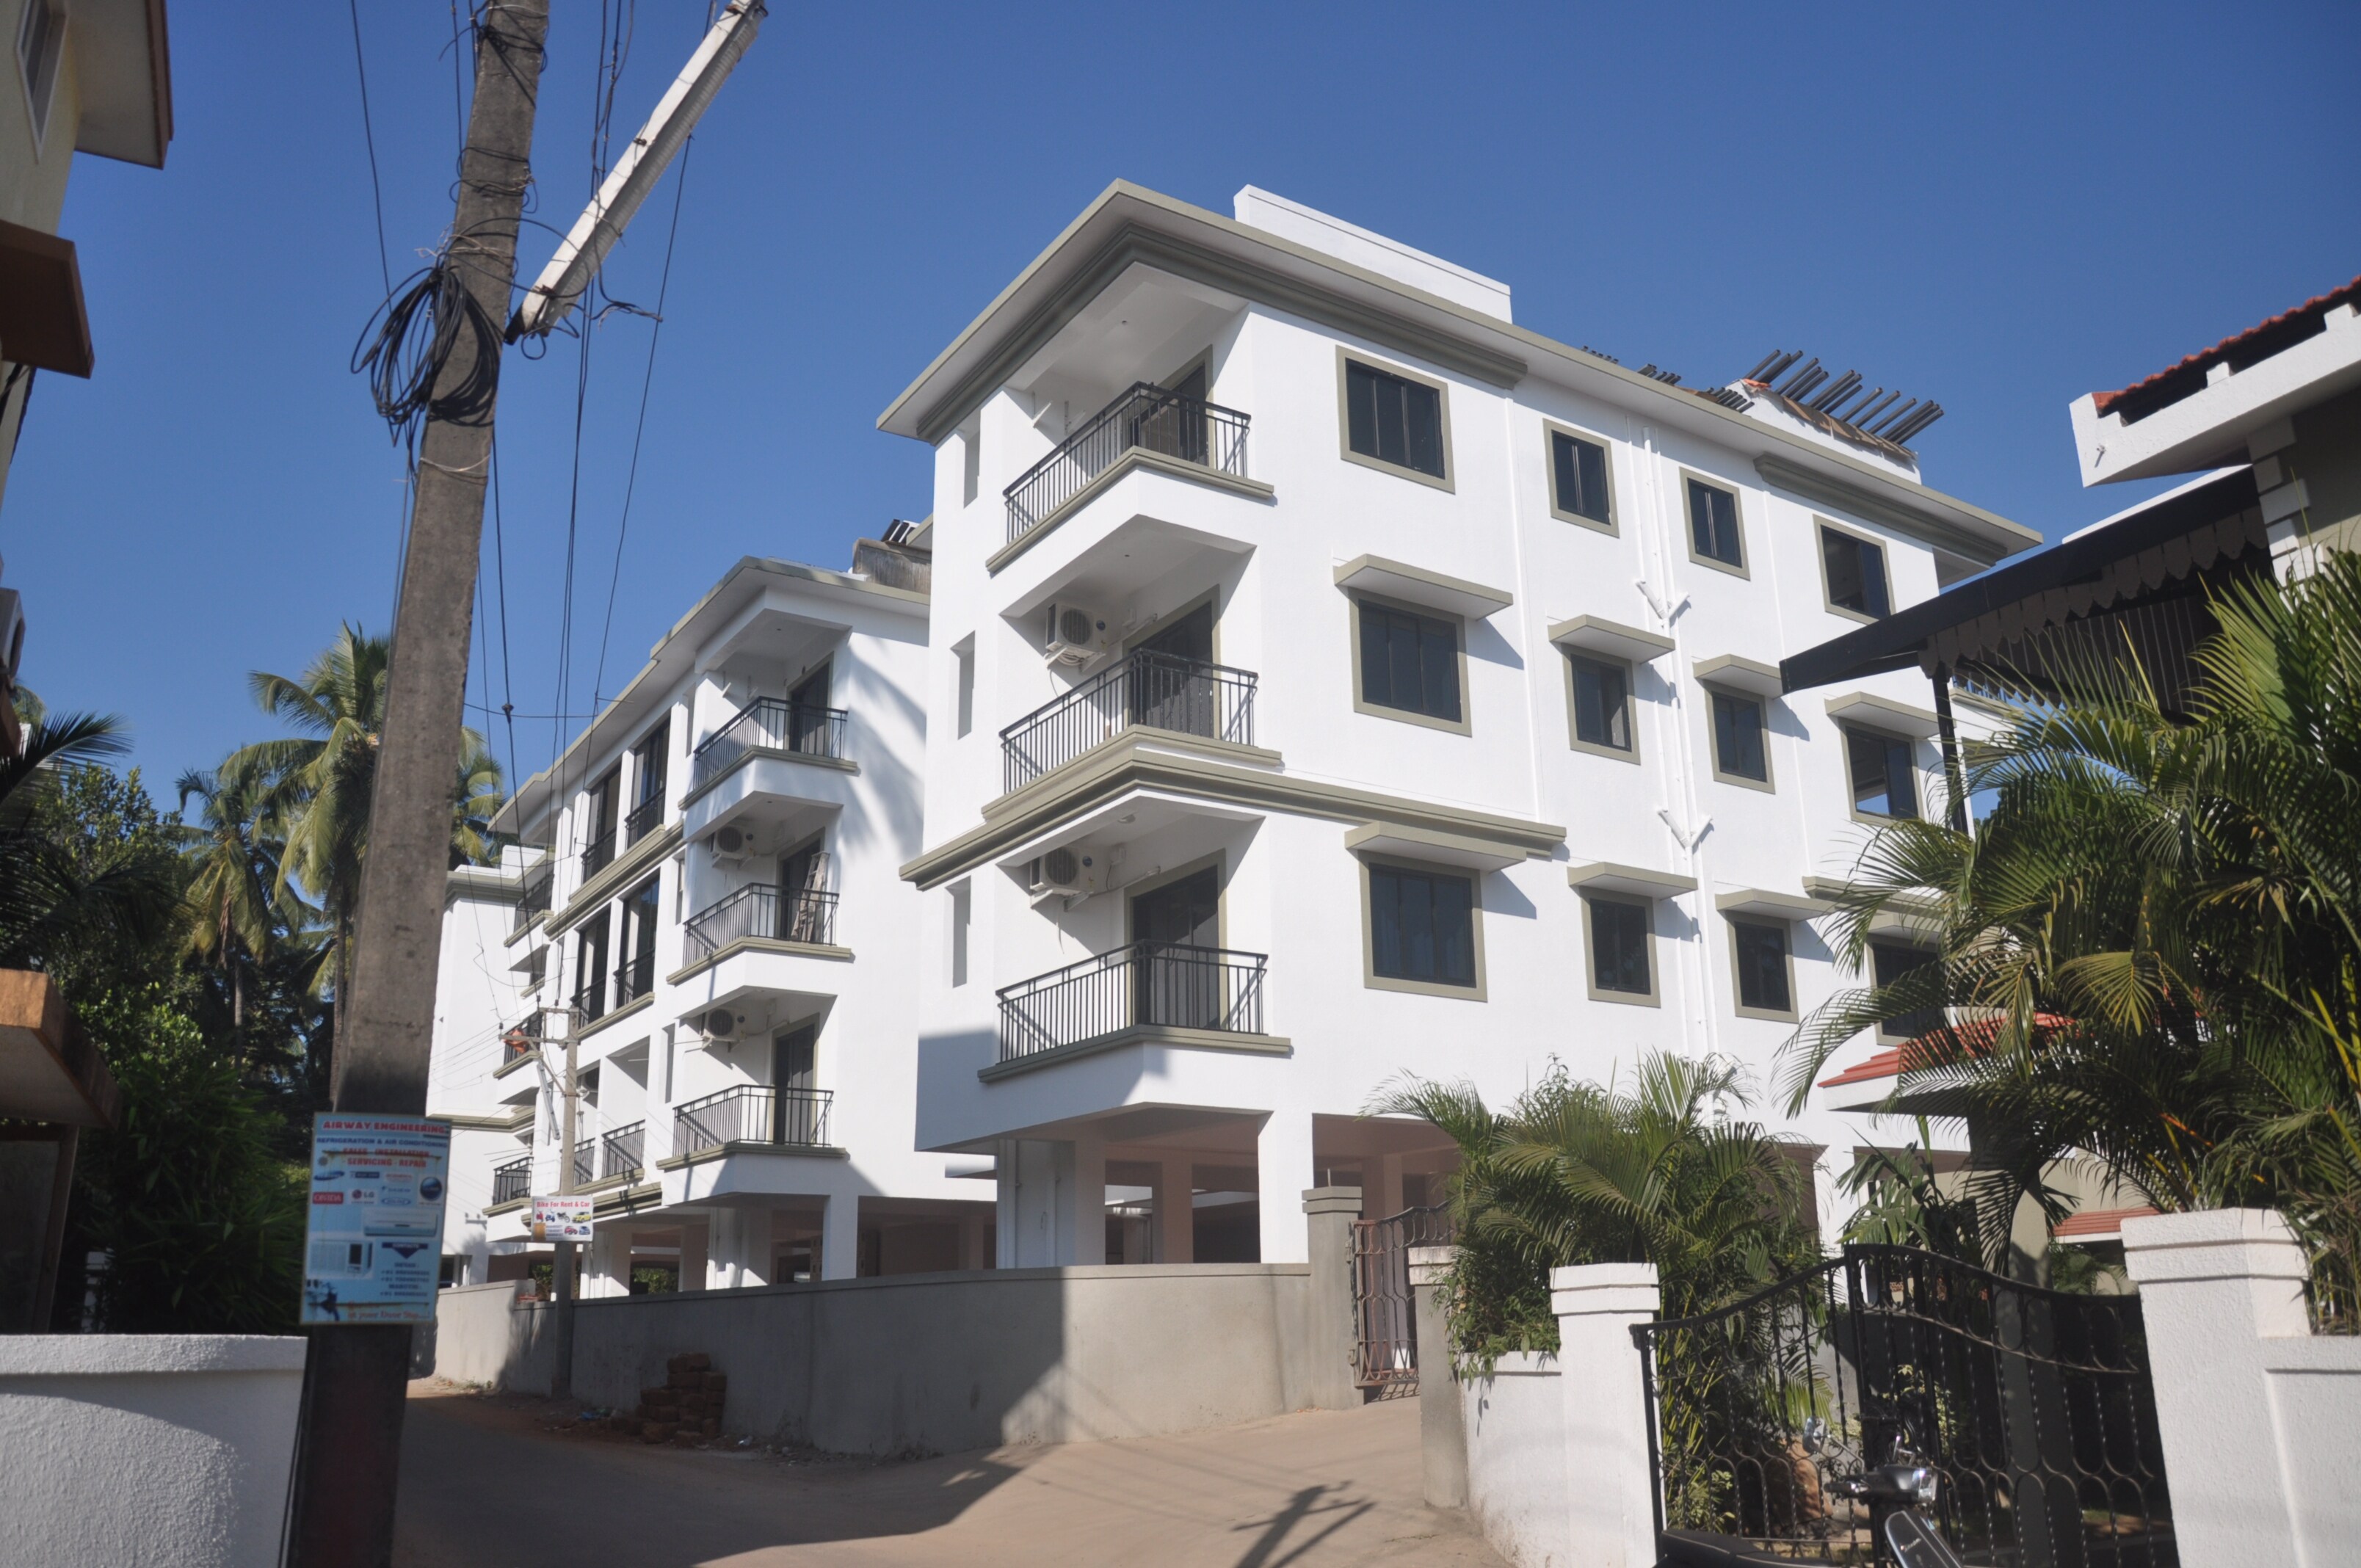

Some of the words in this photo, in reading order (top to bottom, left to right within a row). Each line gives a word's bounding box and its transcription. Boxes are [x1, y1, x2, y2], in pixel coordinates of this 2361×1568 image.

[323, 1120, 371, 1130] AIRWAY
[374, 1122, 446, 1134] ENGINEERING
[399, 1139, 447, 1148] CONDITIONING
[347, 1158, 393, 1166] SERVICING
[399, 1159, 427, 1168] REPAIR
